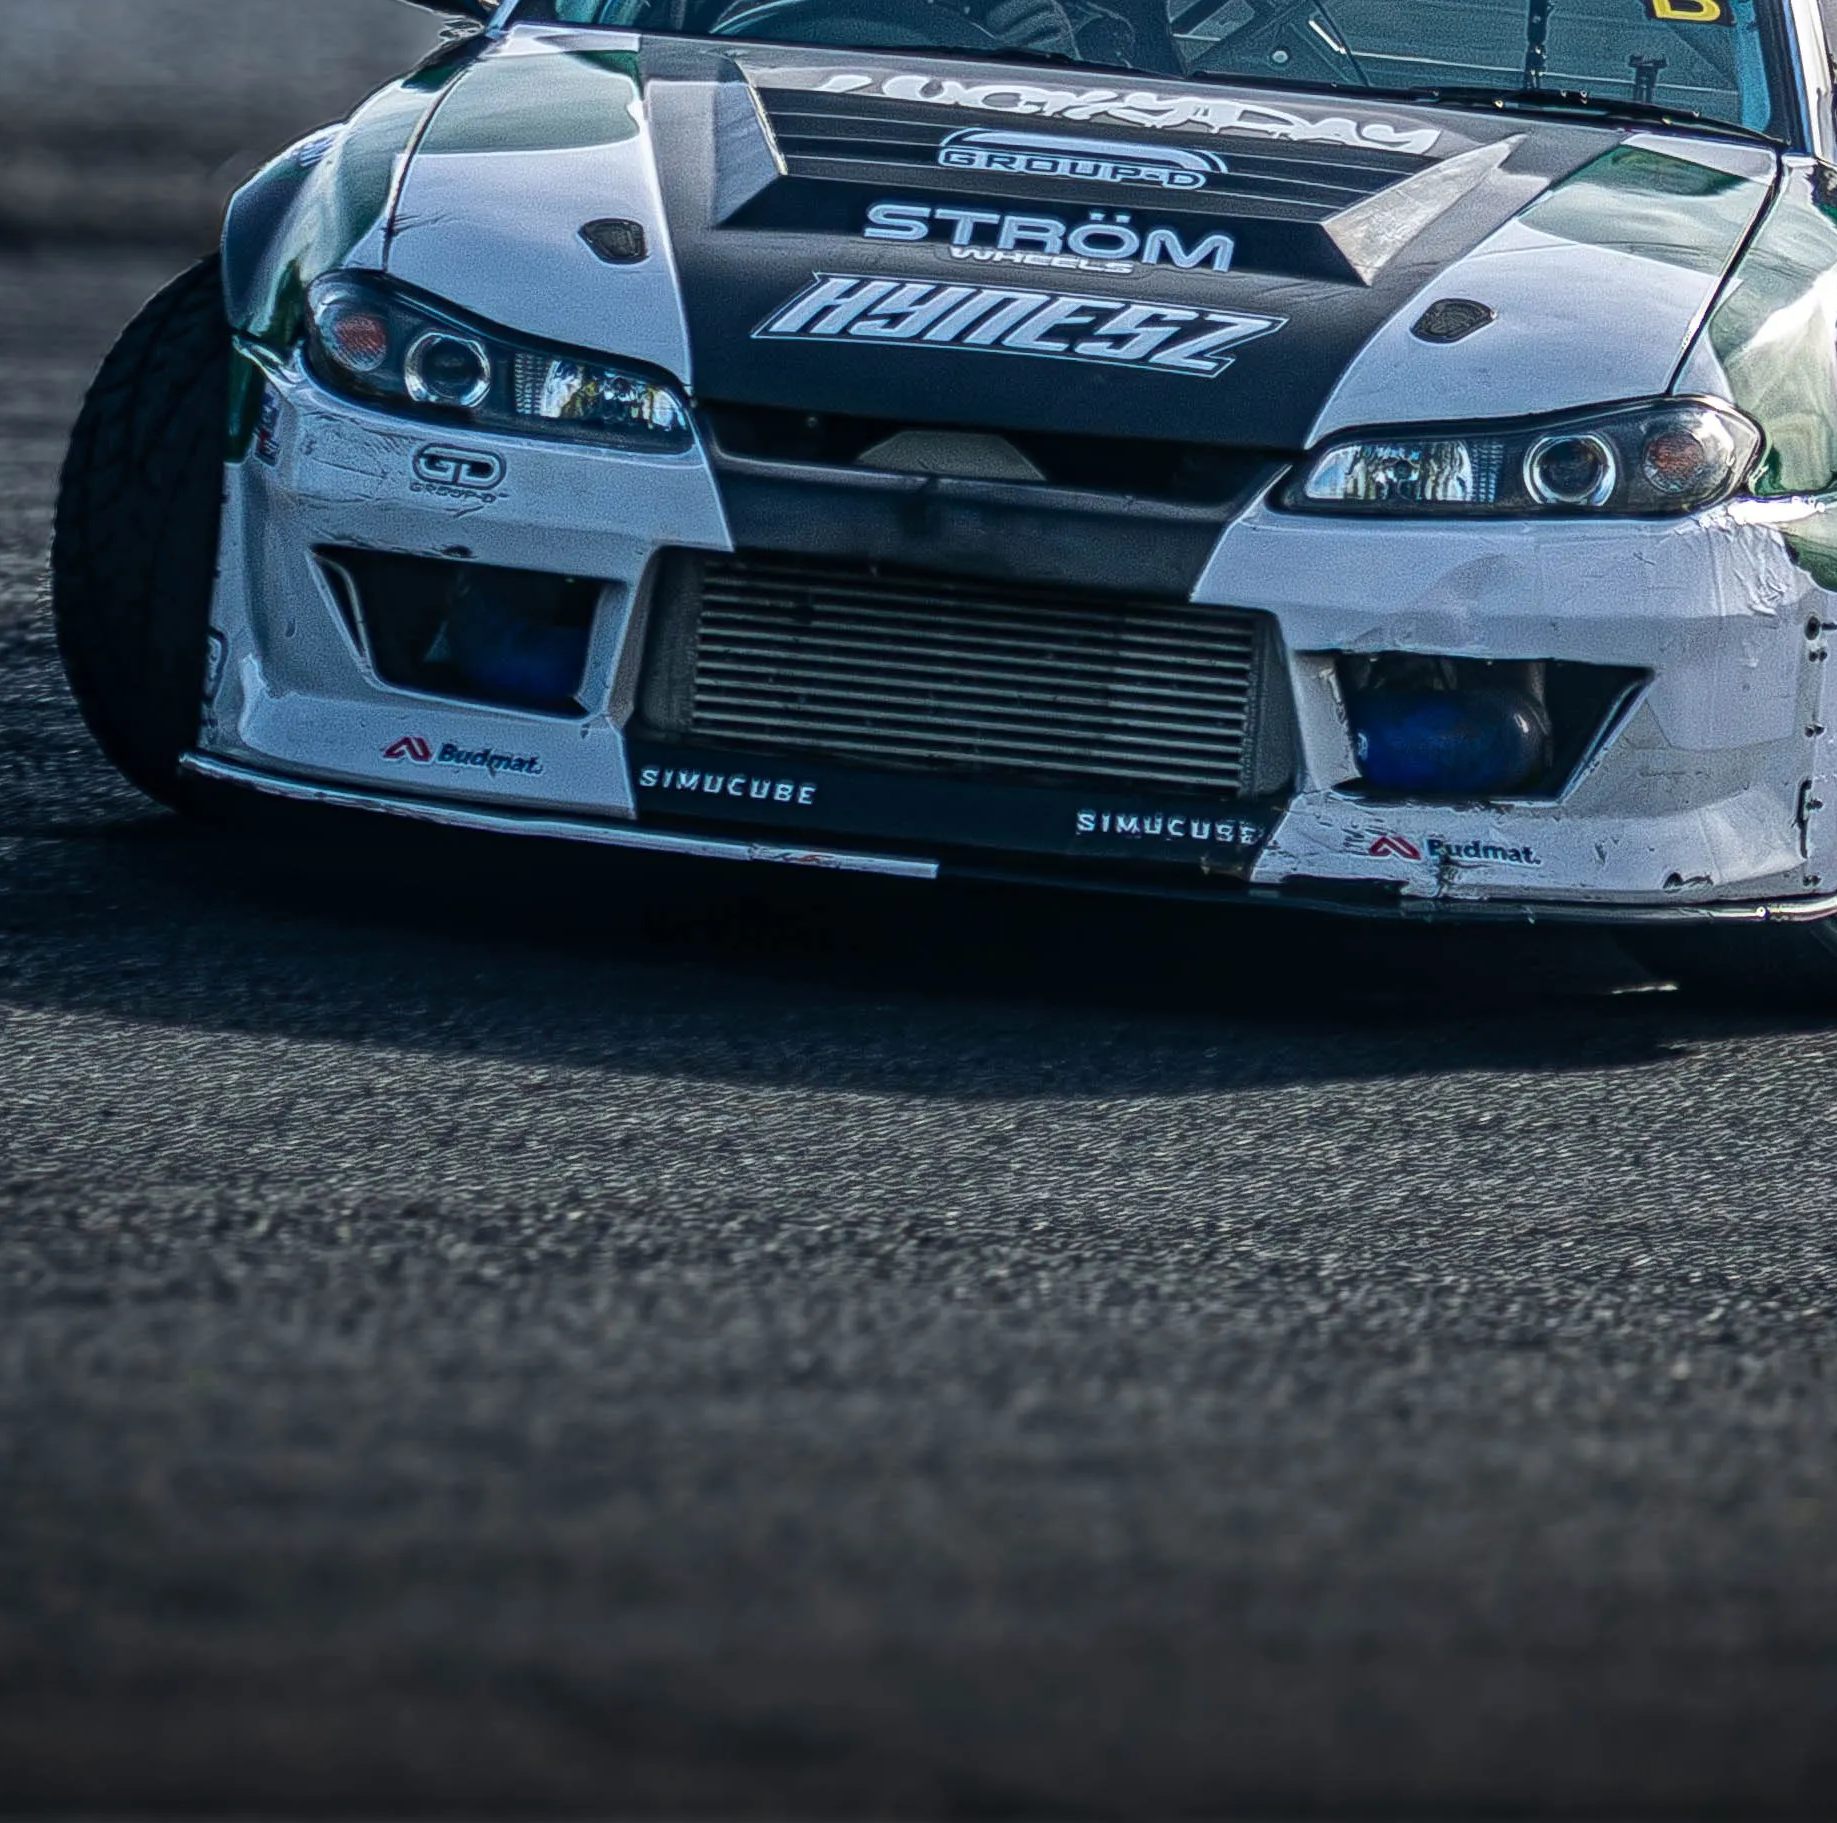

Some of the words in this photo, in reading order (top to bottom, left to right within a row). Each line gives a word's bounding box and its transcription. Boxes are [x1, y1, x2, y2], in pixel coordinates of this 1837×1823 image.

[941, 148, 1205, 189] GROUP-D
[864, 202, 1235, 272] STRÖM
[949, 246, 1133, 274] WHEELS
[639, 765, 818, 805] SIMUCUBE
[1076, 810, 1257, 845] SIMUCUBE
